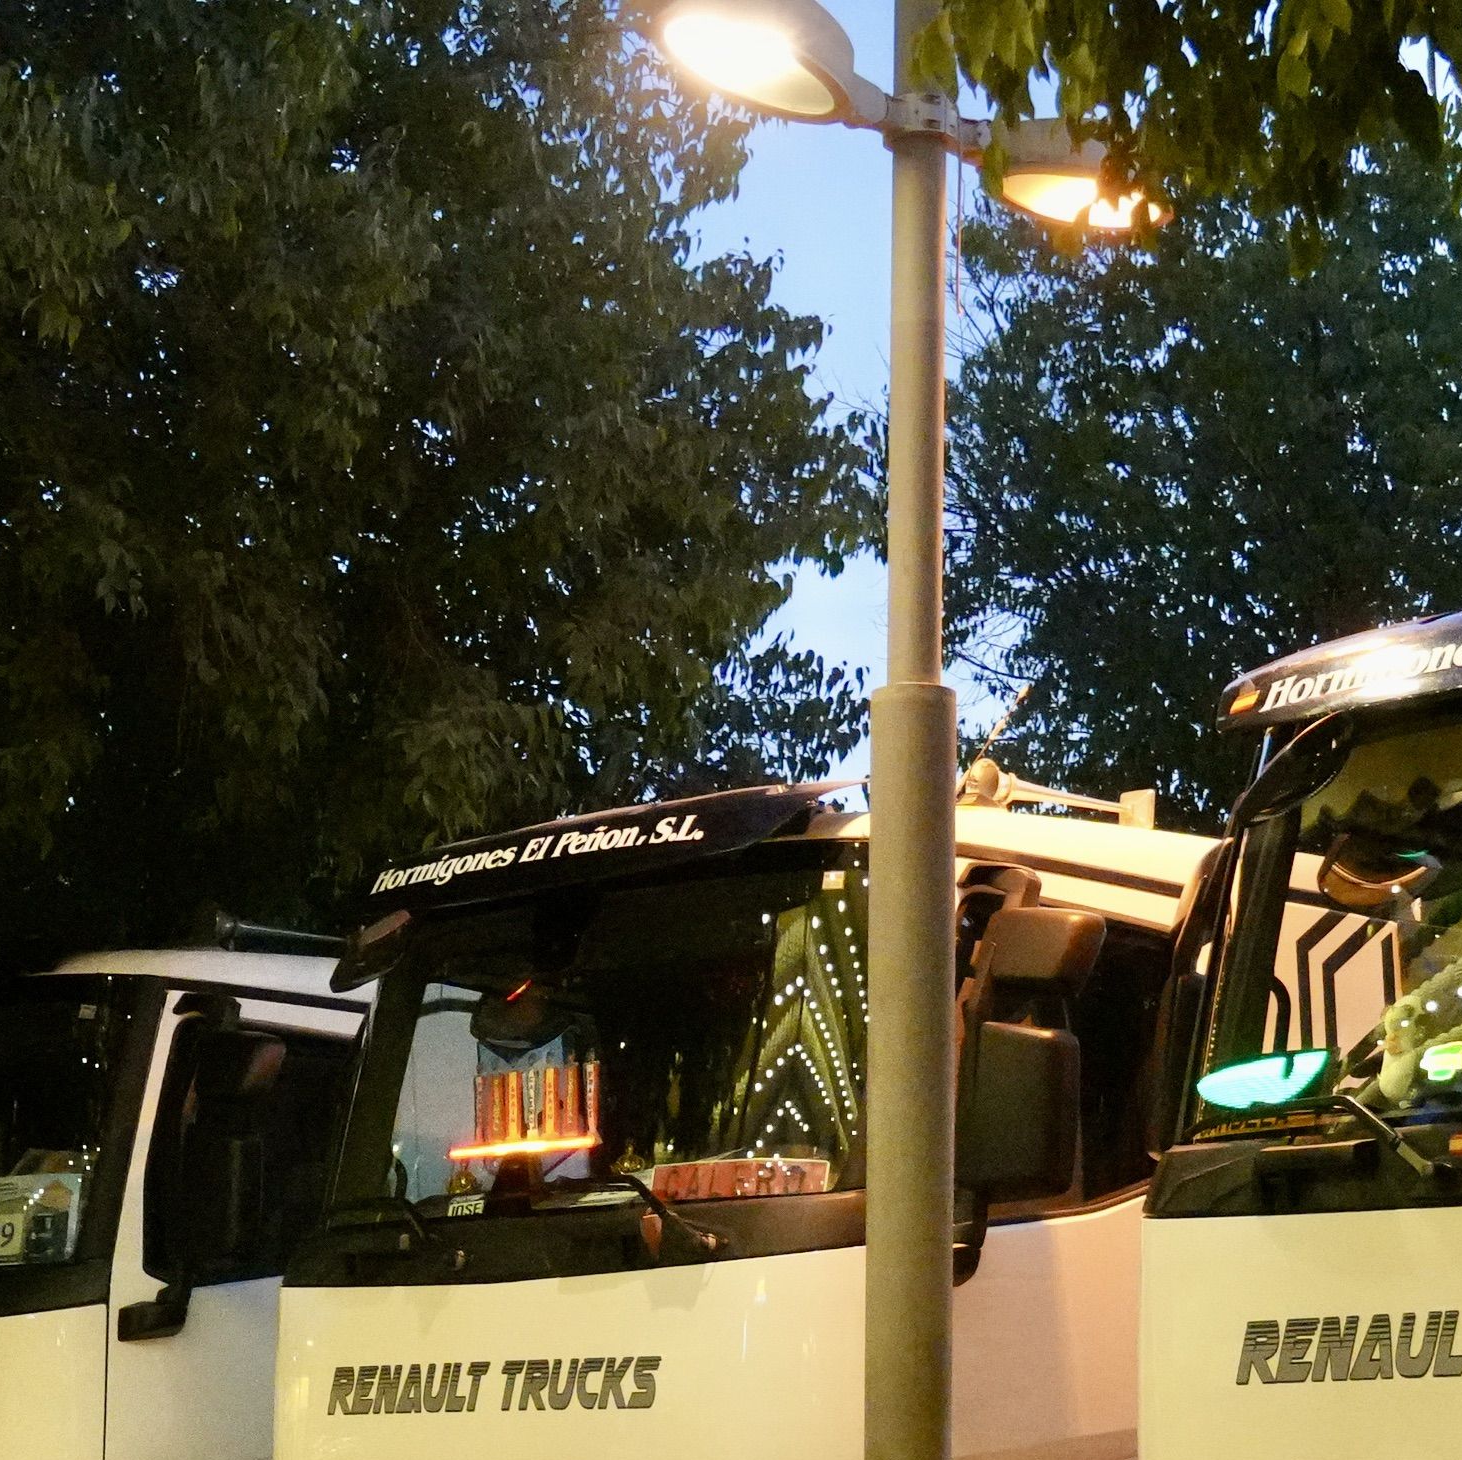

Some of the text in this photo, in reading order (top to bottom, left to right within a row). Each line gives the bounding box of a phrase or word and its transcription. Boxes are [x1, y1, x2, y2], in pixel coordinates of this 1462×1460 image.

[369, 814, 705, 894] Hormigones El Peñon, S.L.
[327, 1355, 662, 1416] RENAULT TRUCKS
